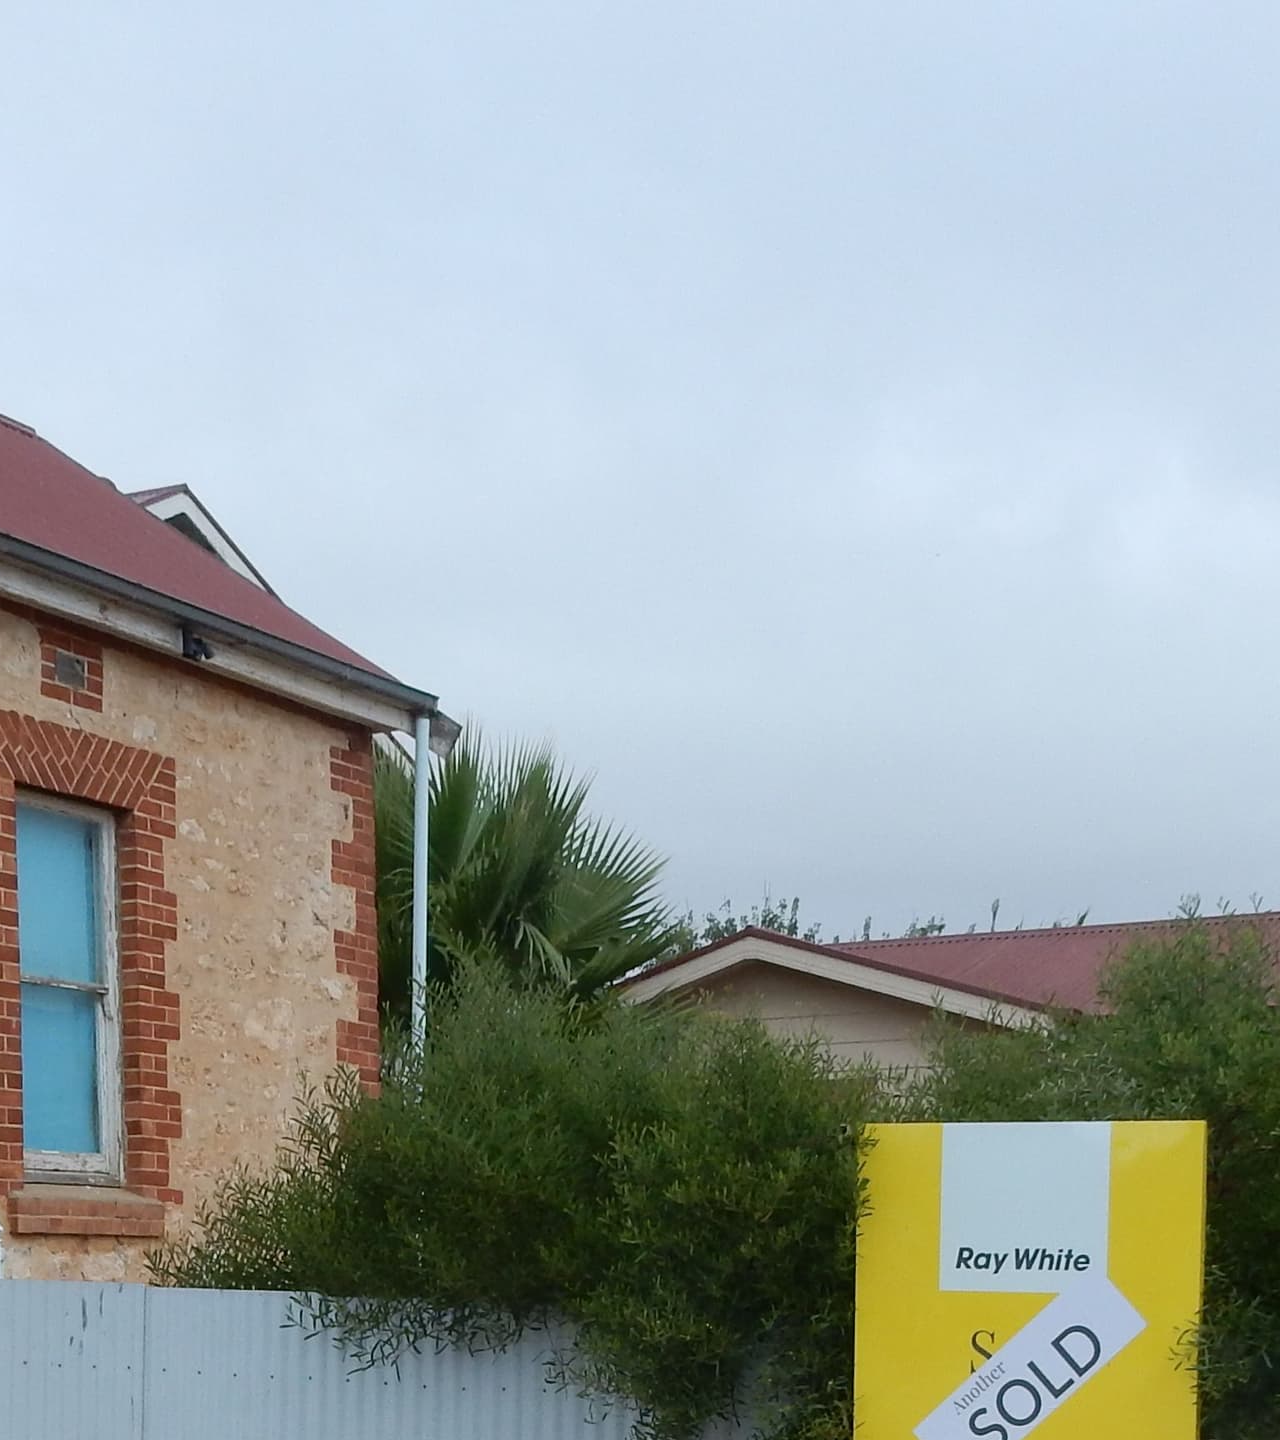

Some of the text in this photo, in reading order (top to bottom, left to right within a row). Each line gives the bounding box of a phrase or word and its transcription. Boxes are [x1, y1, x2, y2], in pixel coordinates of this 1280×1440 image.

[955, 1247, 1091, 1274] Ray White
[953, 1361, 1006, 1415] Another
